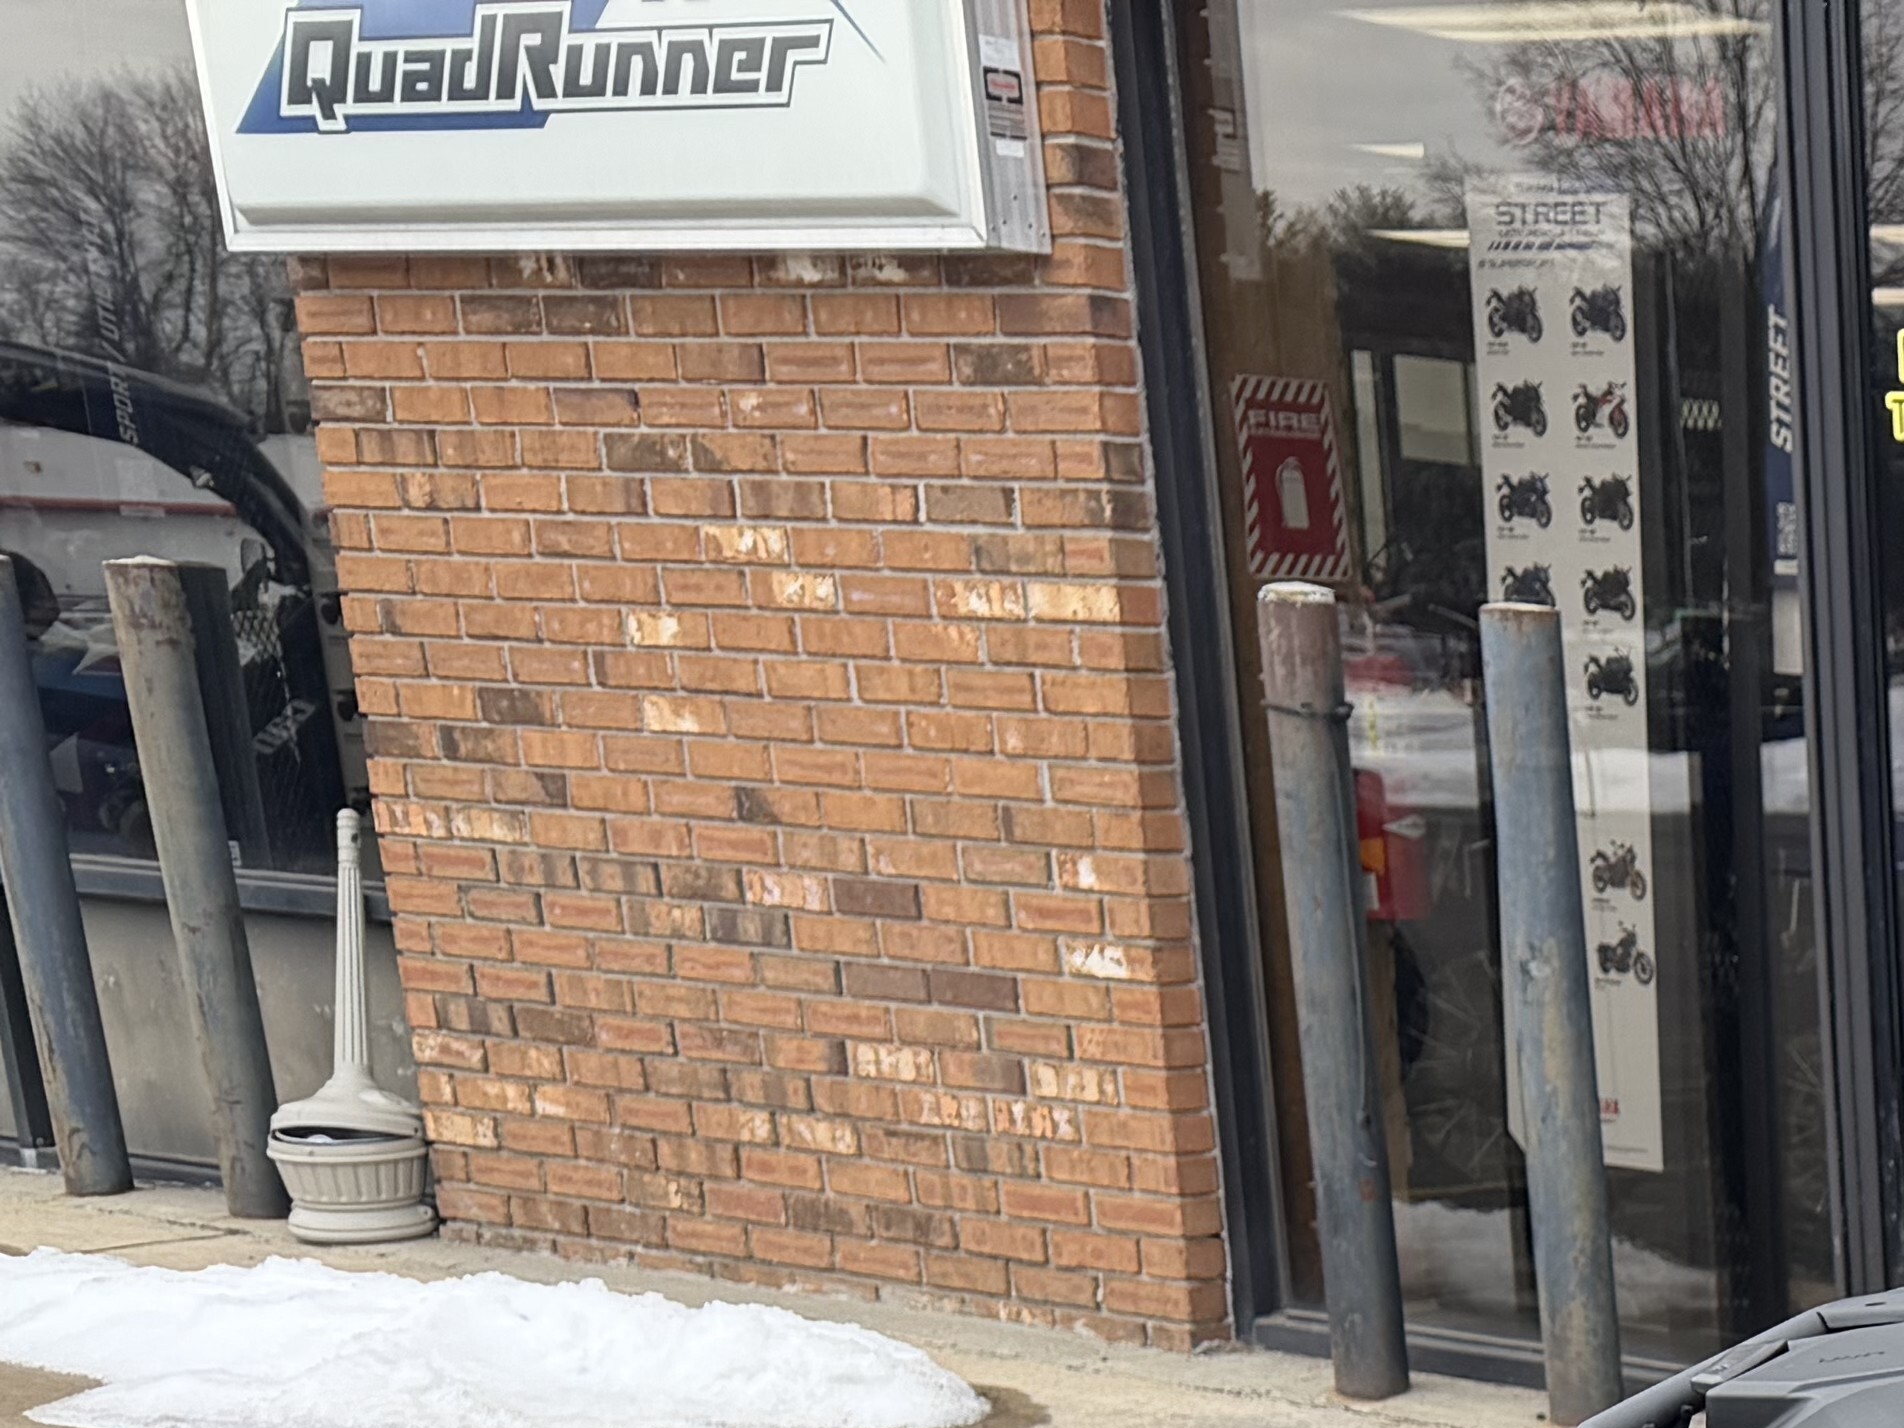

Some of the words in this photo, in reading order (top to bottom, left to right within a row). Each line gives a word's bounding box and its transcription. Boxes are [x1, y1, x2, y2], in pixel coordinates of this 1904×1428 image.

[282, 6, 831, 131] QuadRunner
[1494, 200, 1606, 227] STREET
[108, 360, 140, 446] SPORT
[1247, 409, 1321, 430] FIRE
[1767, 303, 1794, 455] STREET
